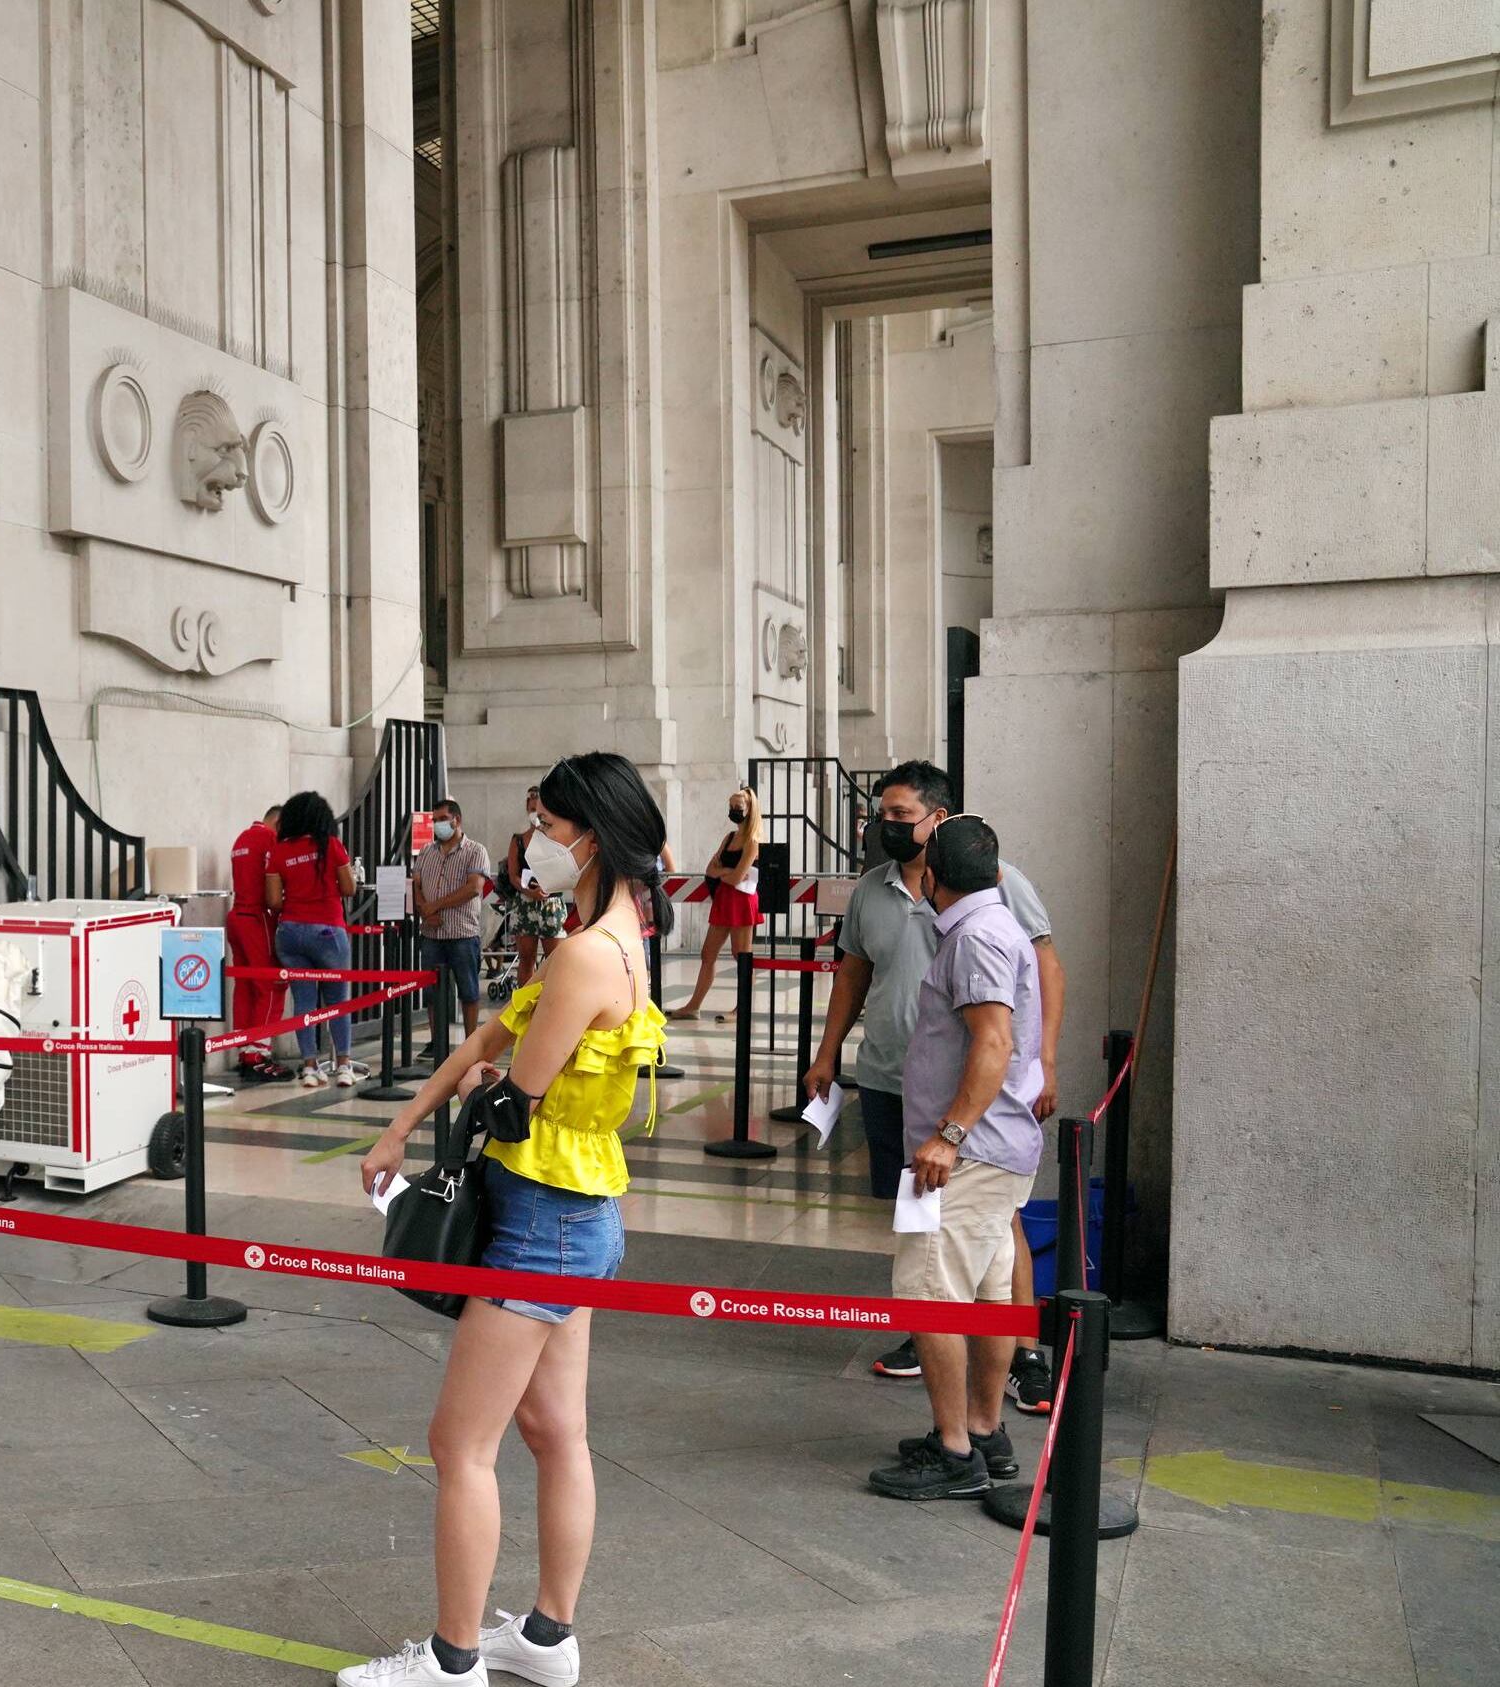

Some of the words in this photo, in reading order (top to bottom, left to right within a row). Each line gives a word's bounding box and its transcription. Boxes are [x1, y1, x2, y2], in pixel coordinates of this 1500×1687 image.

[55, 1043, 75, 1051] Croce
[76, 1043, 98, 1051] Rossa
[99, 1043, 124, 1051] Italiana
[211, 1040, 223, 1049] Croce
[222, 1038, 234, 1046] Rossa
[269, 1253, 307, 1269] Croce
[311, 1258, 352, 1274] Rossa
[356, 1263, 405, 1281] Italiana
[720, 1299, 768, 1316] Croce
[773, 1302, 825, 1320] Rossa
[830, 1306, 890, 1324] Italiana
